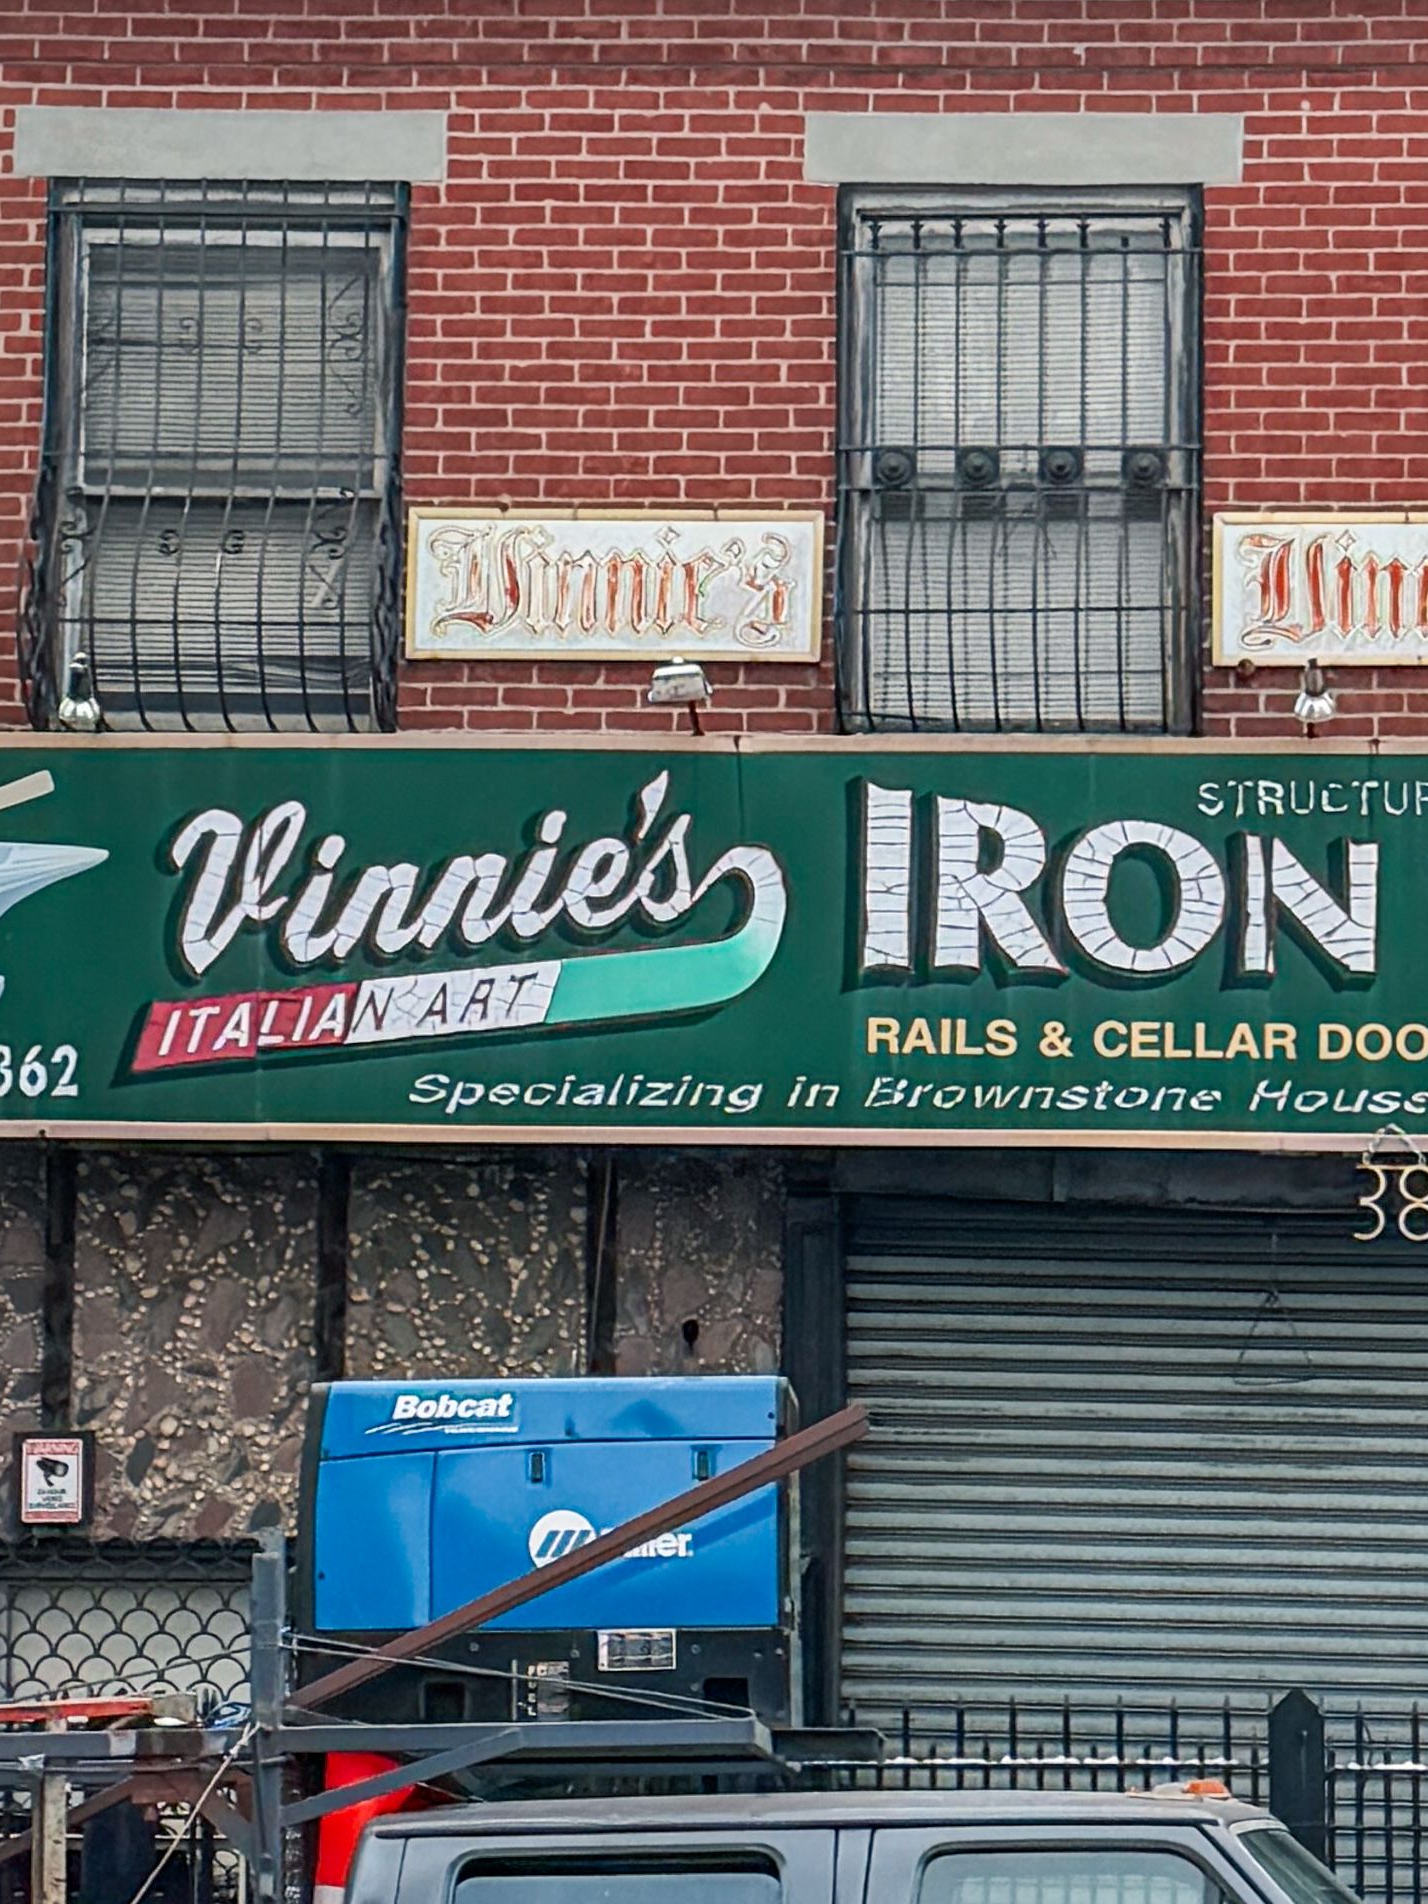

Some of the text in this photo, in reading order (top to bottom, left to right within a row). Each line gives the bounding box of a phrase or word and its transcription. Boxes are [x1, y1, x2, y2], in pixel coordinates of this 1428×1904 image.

[427, 521, 796, 648] Vinnie's
[172, 769, 786, 978] Vinnie's
[862, 781, 1378, 976] IRON
[157, 973, 557, 1056] ITALIAN ART
[868, 1018, 1018, 1059] RAILS
[1040, 1018, 1074, 1060] &
[1093, 1018, 1297, 1062] CELLAR
[409, 1072, 766, 1115] Specializing
[786, 1076, 839, 1107] in
[865, 1074, 1222, 1114] Brownstone
[392, 1393, 513, 1420] Bobcat
